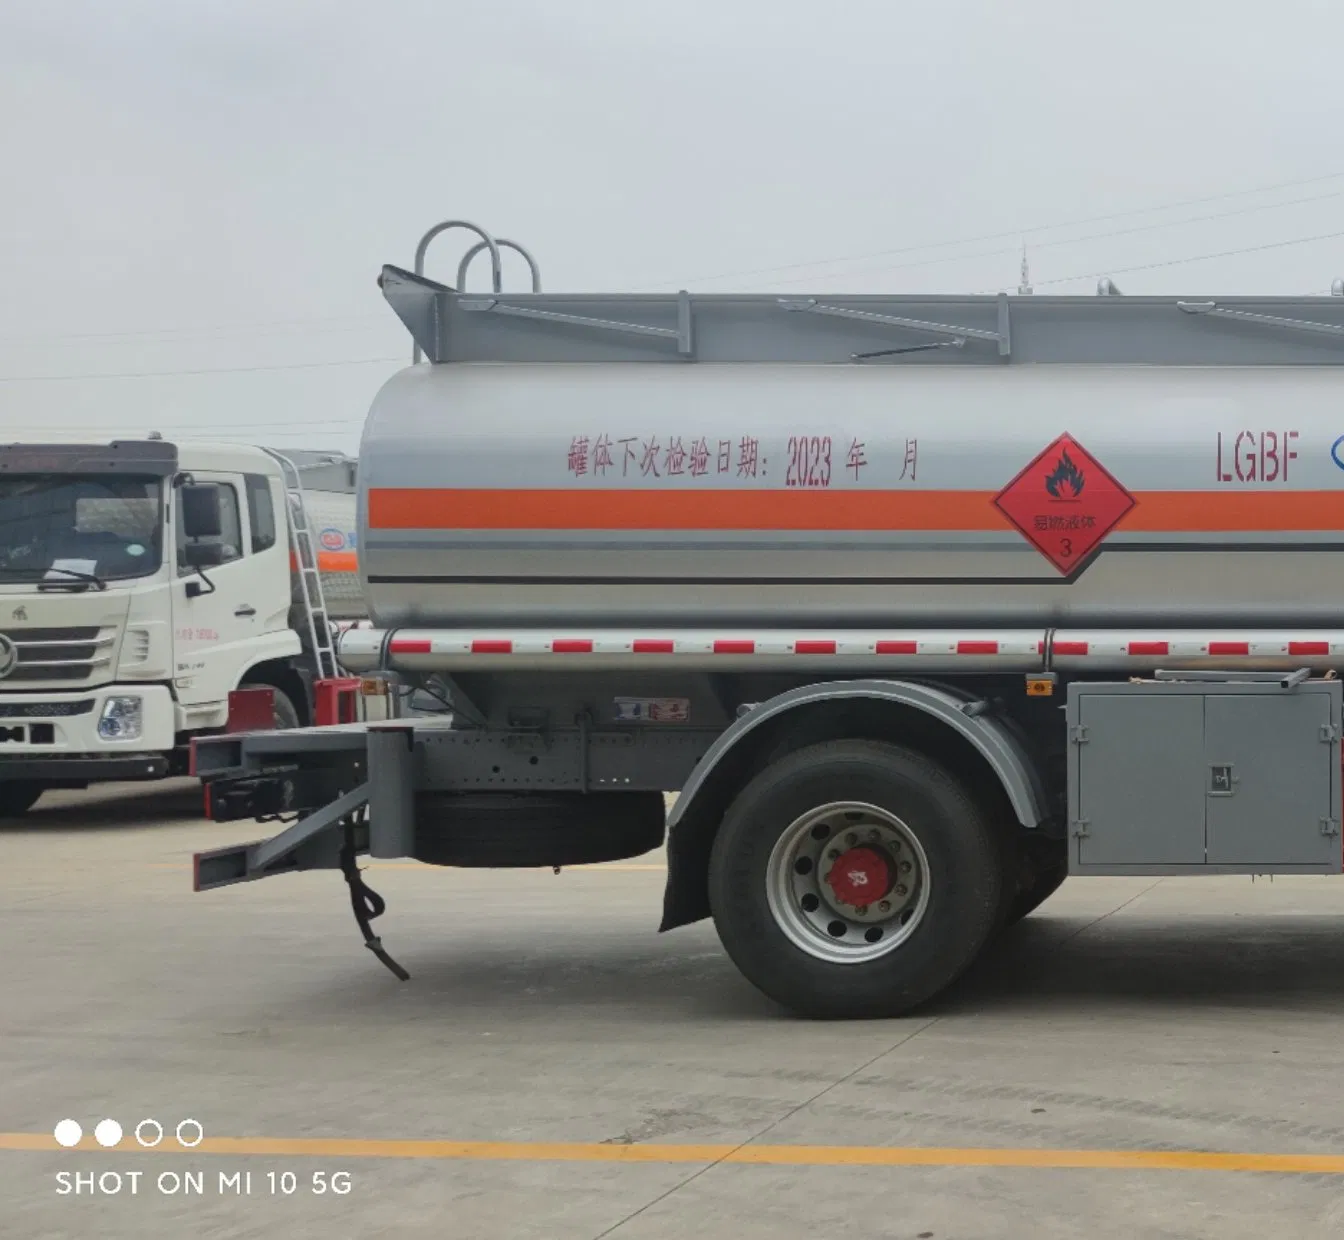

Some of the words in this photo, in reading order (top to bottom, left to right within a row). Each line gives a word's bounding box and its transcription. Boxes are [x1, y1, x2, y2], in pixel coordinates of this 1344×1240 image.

[568, 434, 767, 478] 罐体下次检验日期:
[786, 436, 831, 486] 2023
[846, 437, 868, 481] 年
[899, 438, 917, 481] 月
[1217, 431, 1298, 482] LGBF
[1034, 514, 1096, 530] 易燃液体
[1060, 538, 1072, 557] 3
